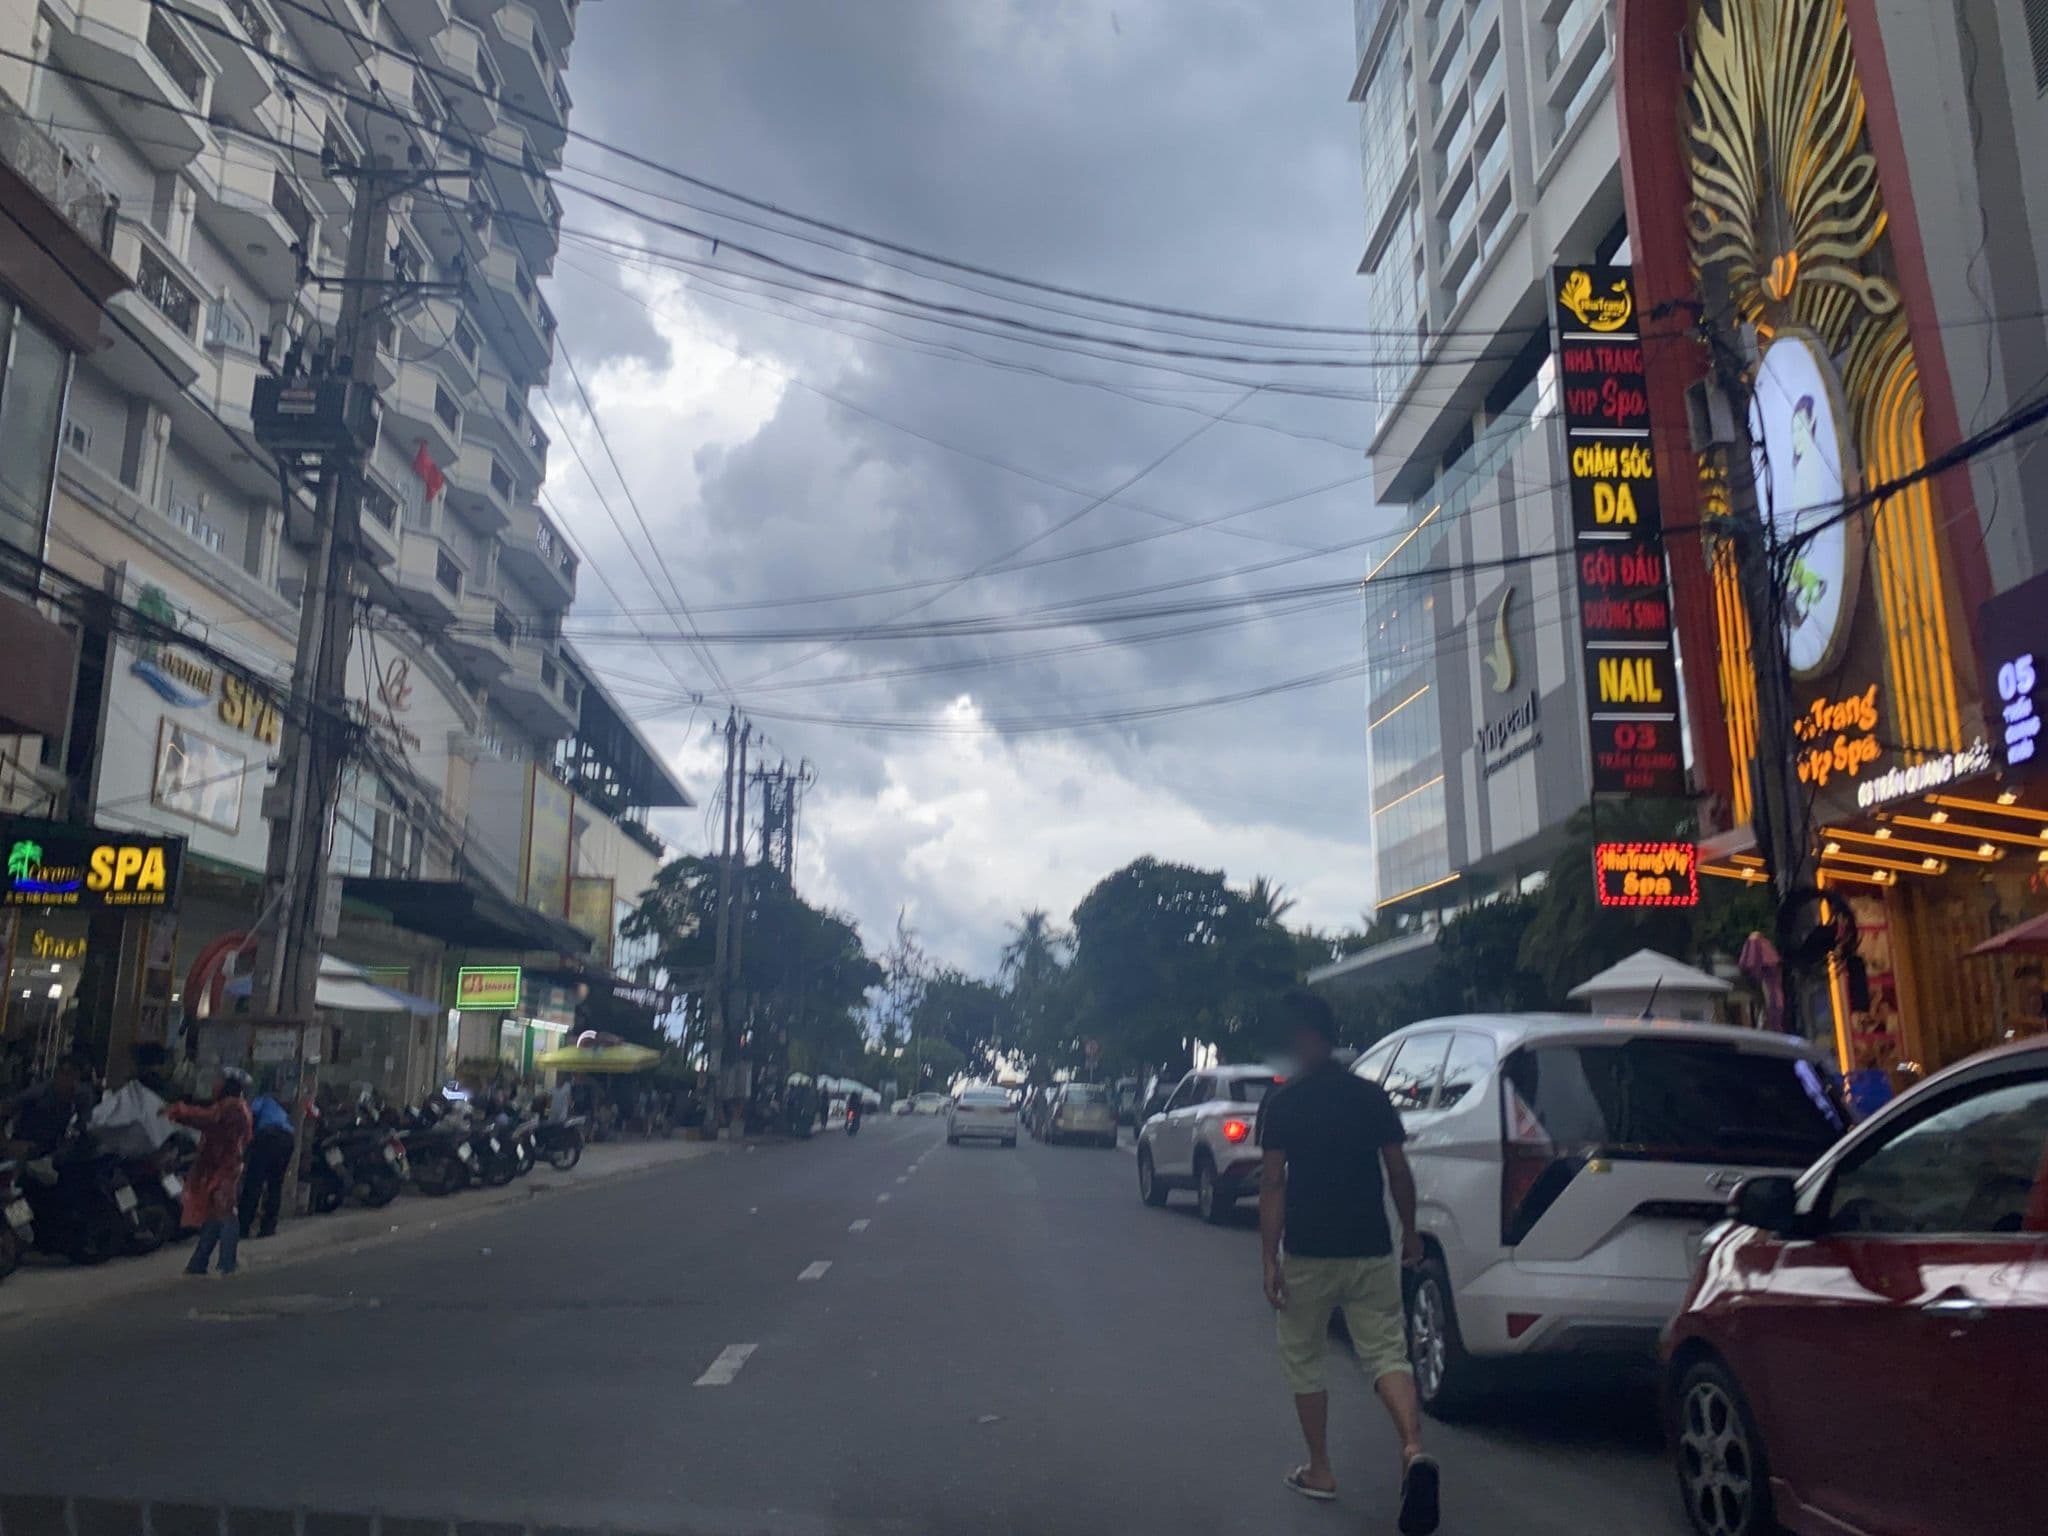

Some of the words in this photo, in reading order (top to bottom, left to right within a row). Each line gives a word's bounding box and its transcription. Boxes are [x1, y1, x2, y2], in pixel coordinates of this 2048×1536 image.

[1564, 350, 1595, 373] NHA
[1597, 349, 1643, 374] TRANG
[1567, 388, 1598, 415] VIP
[1601, 377, 1646, 427] Spa
[1619, 442, 1653, 479] SÓC
[1593, 481, 1638, 525] DA
[1598, 657, 1663, 703] NAIL
[1998, 653, 2036, 701] 05
[1810, 683, 1878, 732] Trang
[1614, 723, 1657, 750] 03
[1833, 734, 1881, 777] Spa
[86, 845, 167, 891] SPA
[1623, 871, 1672, 896] Spa
